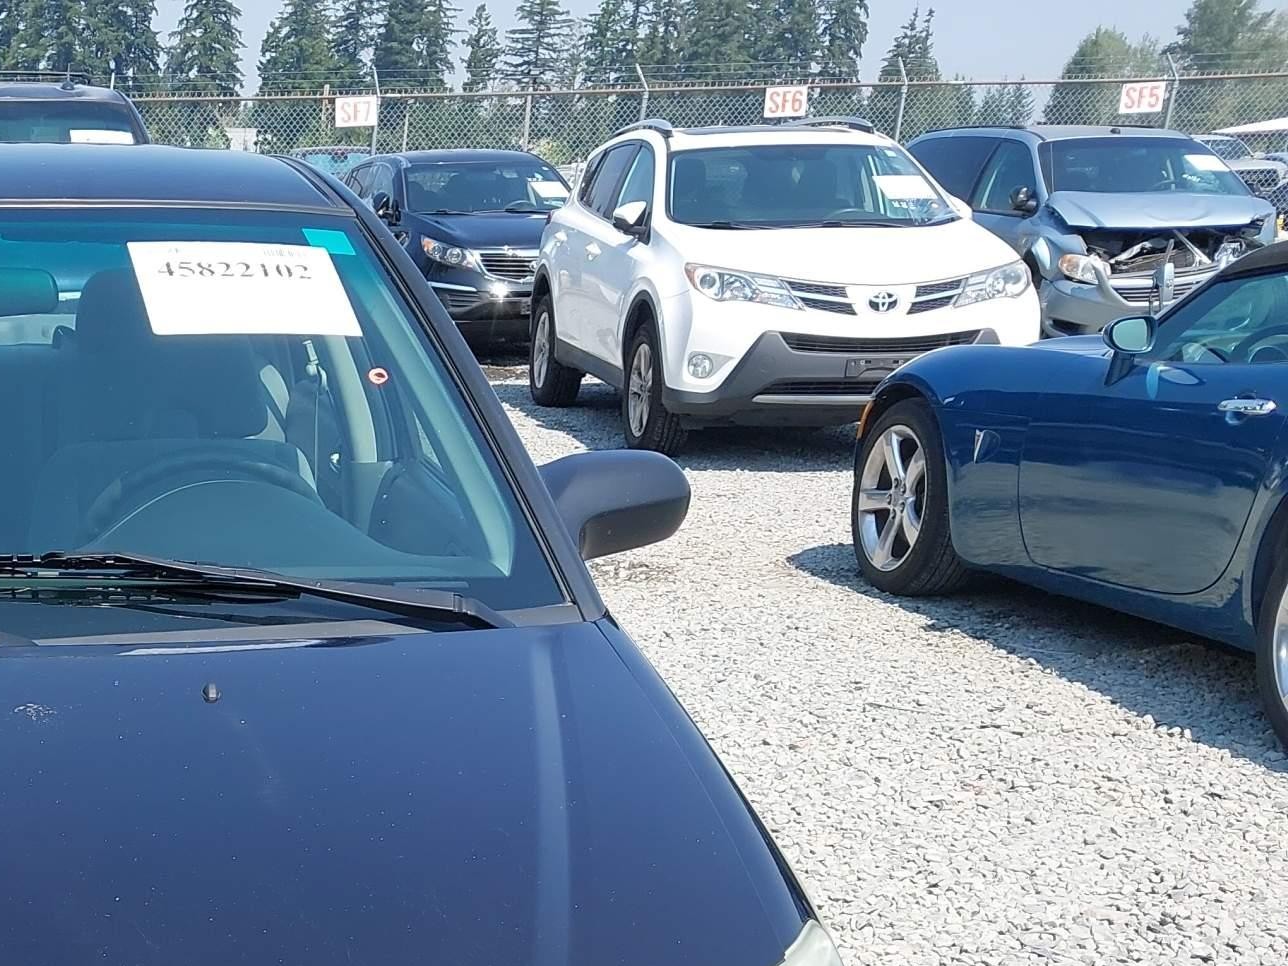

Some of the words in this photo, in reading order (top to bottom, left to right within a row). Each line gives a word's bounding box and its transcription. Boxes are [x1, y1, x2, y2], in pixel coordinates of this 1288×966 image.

[768, 90, 803, 113] SF6
[1123, 85, 1161, 109] SF5
[340, 100, 371, 123] SF7
[157, 261, 312, 280] 45822102
